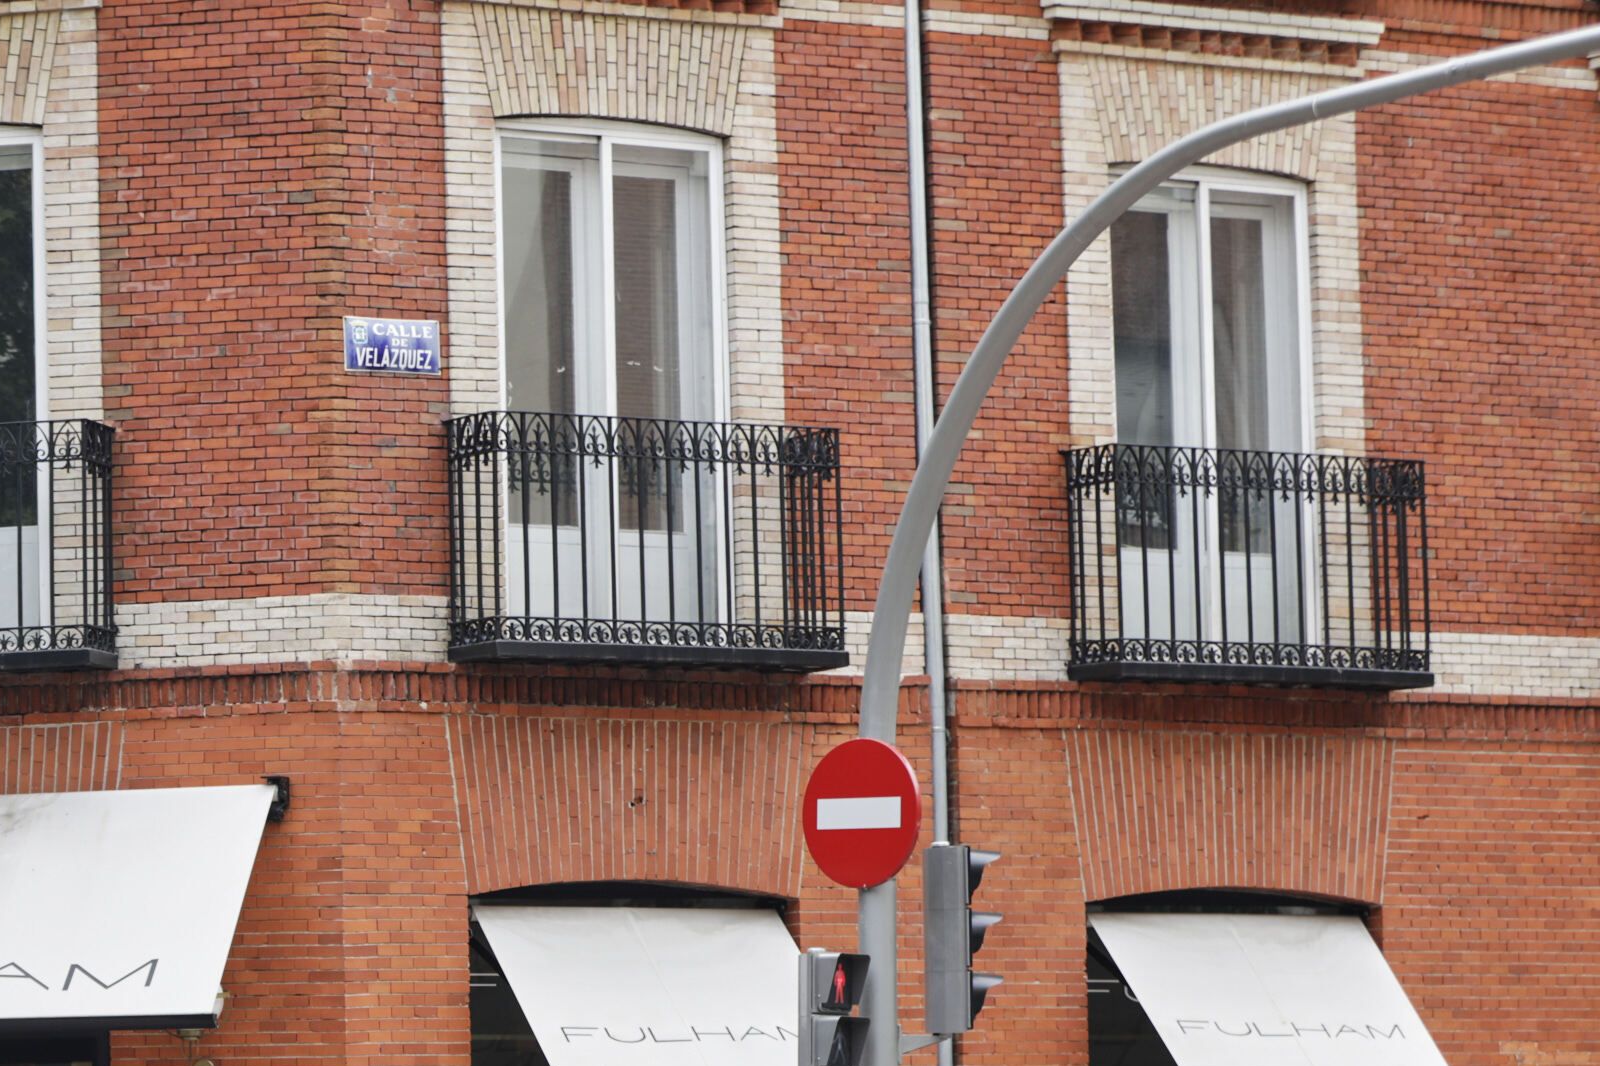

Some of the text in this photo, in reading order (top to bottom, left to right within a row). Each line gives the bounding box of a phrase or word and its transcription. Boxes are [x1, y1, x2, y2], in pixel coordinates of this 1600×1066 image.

[372, 322, 433, 339] CALLE
[391, 337, 409, 347] DE
[355, 345, 433, 370] VELÁZQUEZ
[1176, 1019, 1406, 1040] FULHAM
